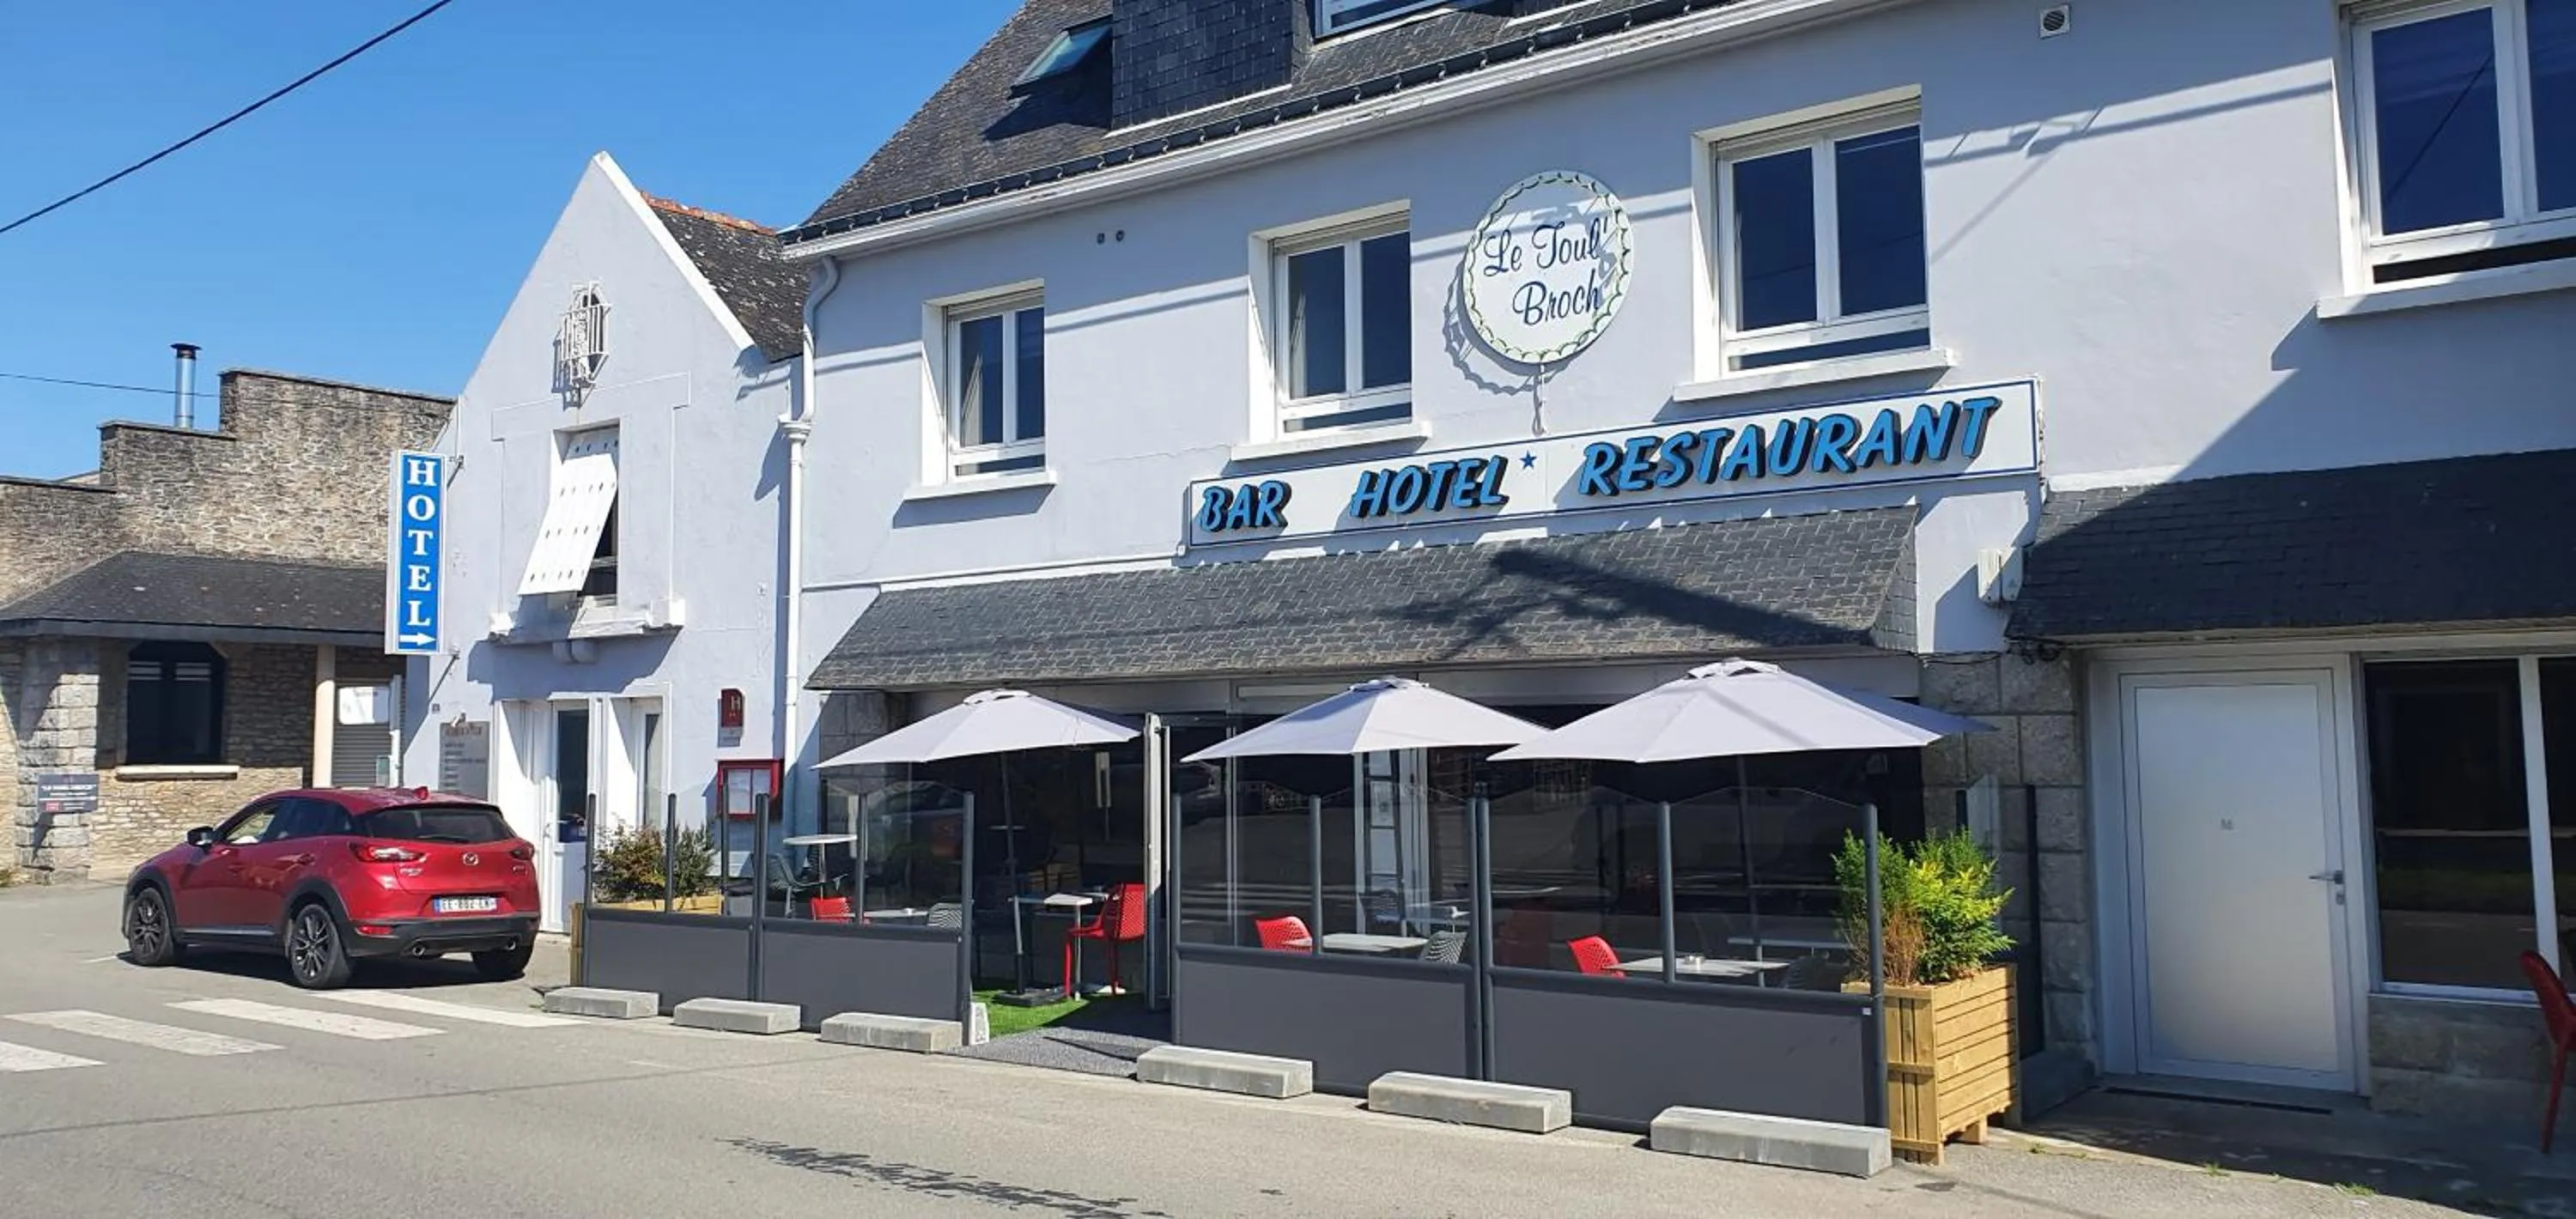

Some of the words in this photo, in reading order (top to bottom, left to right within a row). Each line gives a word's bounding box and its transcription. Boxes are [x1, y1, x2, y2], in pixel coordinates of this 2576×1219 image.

[1483, 228, 1523, 277] Le
[1512, 268, 1600, 326] Broch
[1200, 480, 1291, 532] BAR
[1349, 455, 1509, 519] HOTEL
[1578, 396, 2002, 496] RESTAURANT
[406, 458, 438, 627] HOTEL
[731, 694, 742, 711] H
